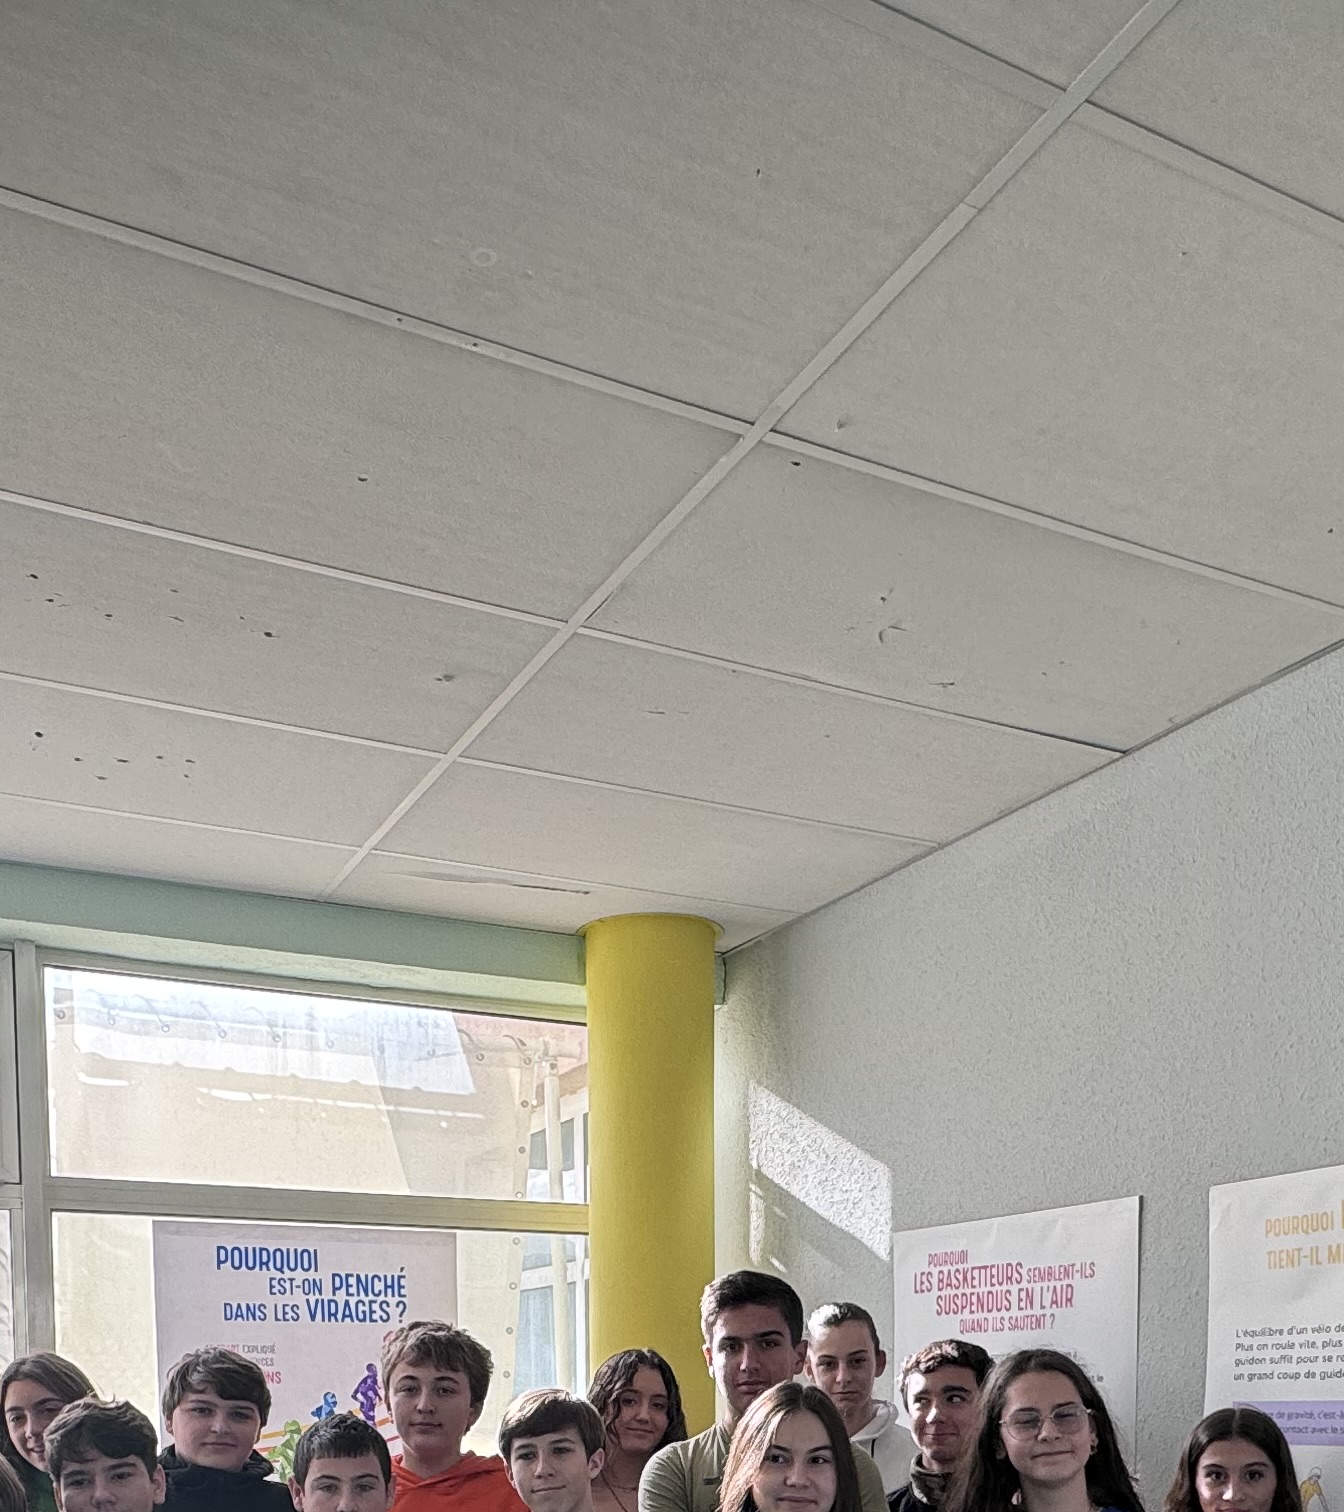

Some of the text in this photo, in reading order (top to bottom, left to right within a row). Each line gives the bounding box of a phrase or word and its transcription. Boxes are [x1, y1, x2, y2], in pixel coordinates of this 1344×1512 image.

[1265, 1211, 1334, 1238] POURQUOI
[216, 1246, 319, 1274] POURQUOI
[928, 1249, 968, 1268] POURQUOI
[1266, 1247, 1322, 1270] TIENT-IL
[269, 1266, 407, 1298] EST-ON PENCHÉ
[914, 1262, 1096, 1294] LES BASKETTEURS SEMBLENT-ILS
[223, 1298, 407, 1323] DANS LES VIRAGES ?
[936, 1284, 1074, 1316] SUSPENDUS EN L'AIR
[959, 1313, 1056, 1335] QUAND ILS SAUTENT ?
